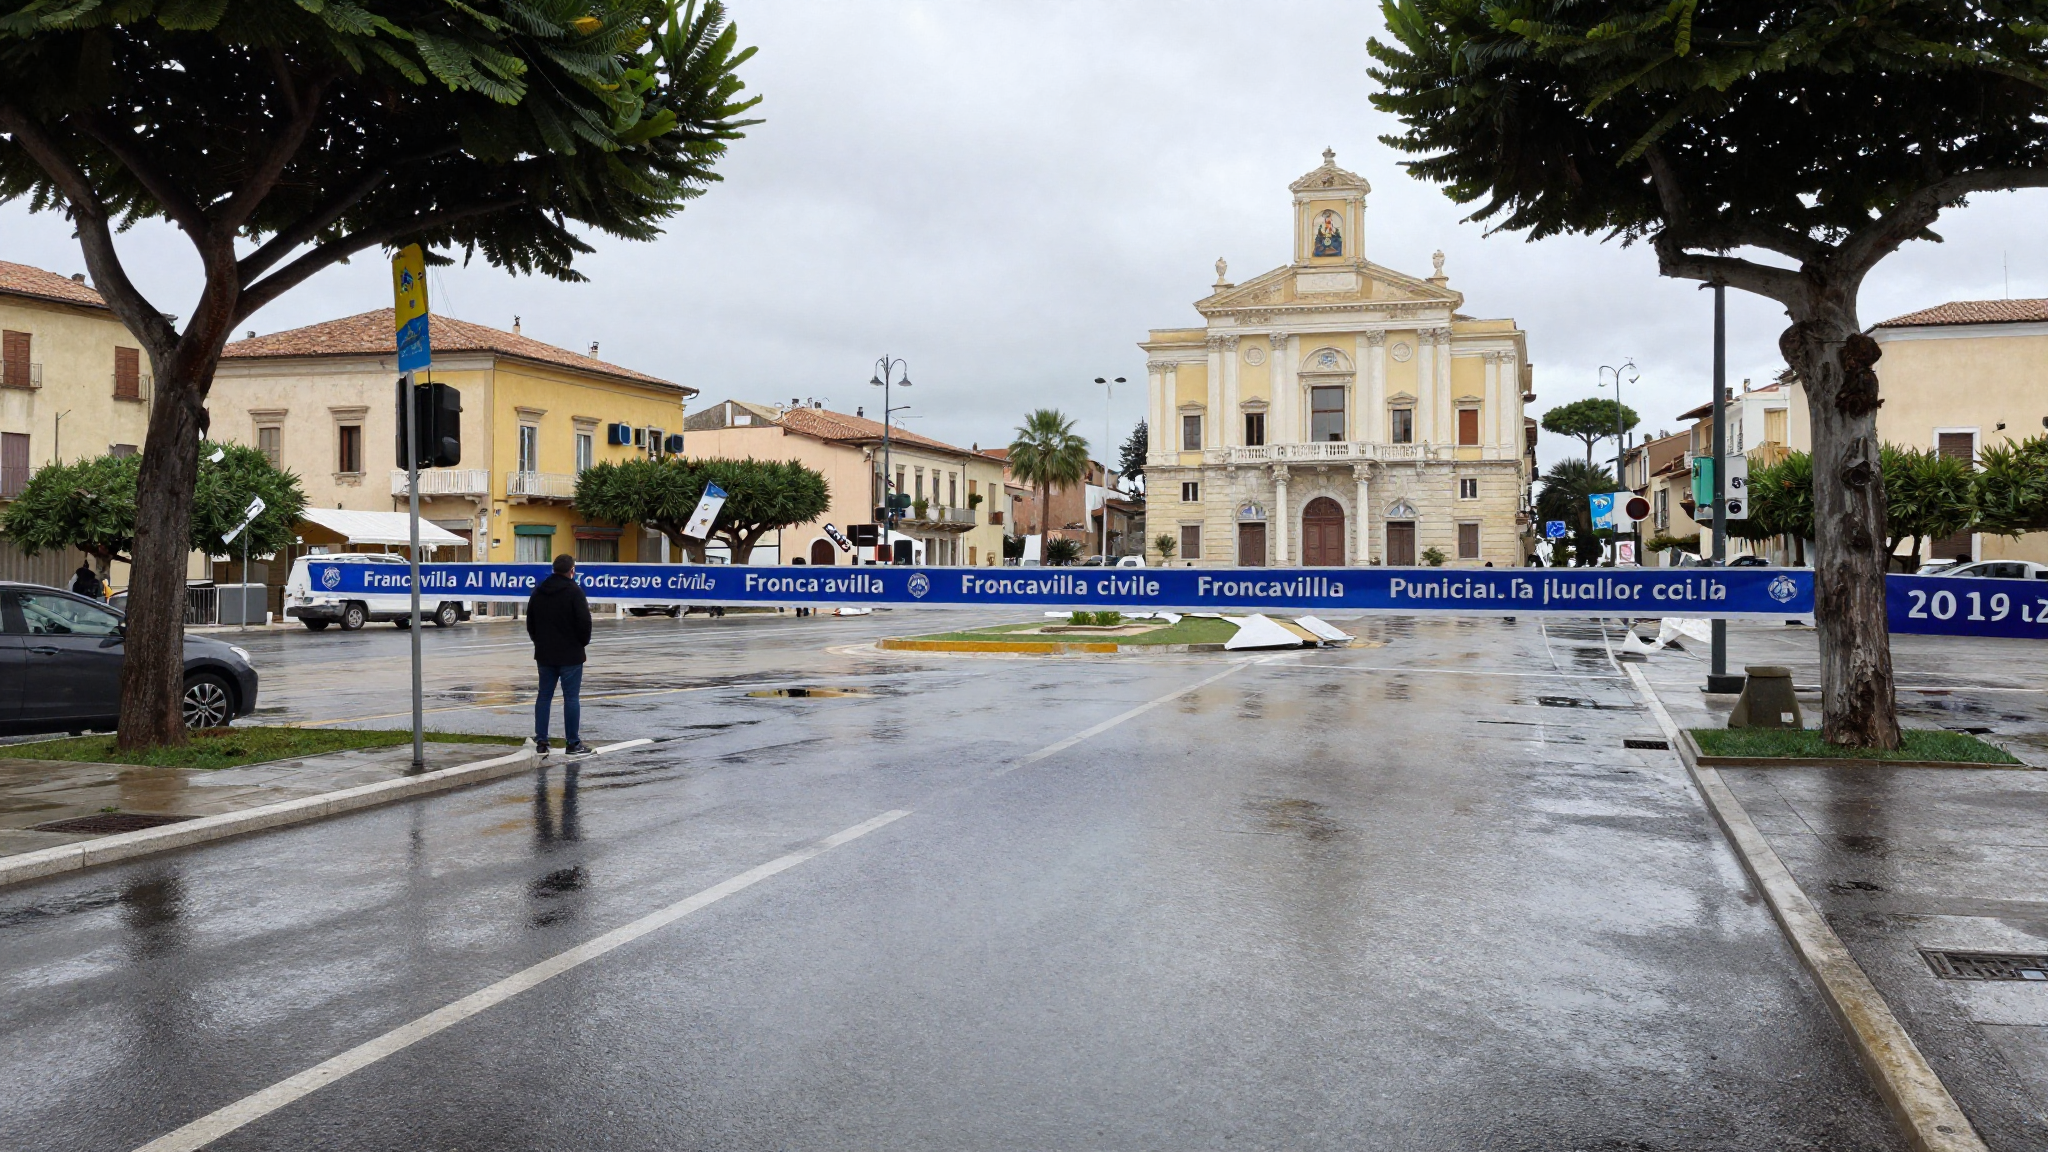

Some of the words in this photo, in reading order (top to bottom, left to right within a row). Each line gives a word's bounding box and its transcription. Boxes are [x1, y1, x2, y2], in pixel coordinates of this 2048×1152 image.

[364, 571, 457, 588] Francvilla
[465, 572, 483, 588] Al
[490, 572, 536, 588] Mare
[1097, 576, 1160, 596] civile
